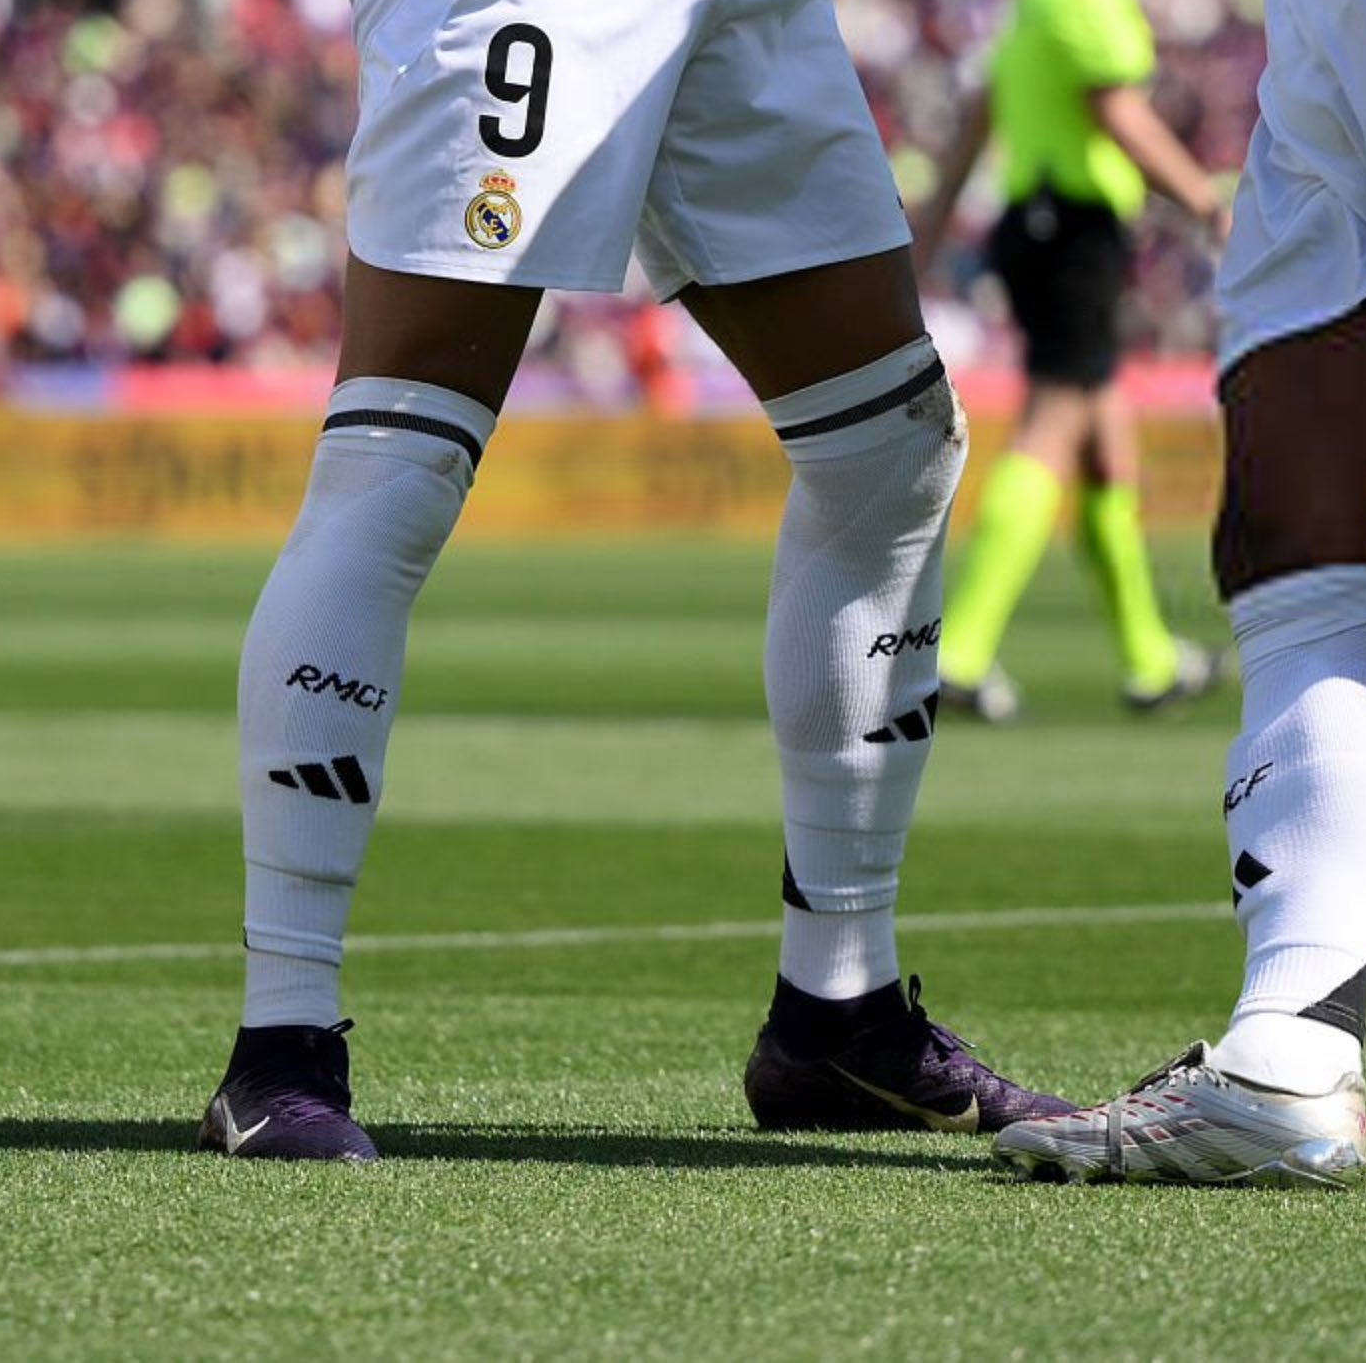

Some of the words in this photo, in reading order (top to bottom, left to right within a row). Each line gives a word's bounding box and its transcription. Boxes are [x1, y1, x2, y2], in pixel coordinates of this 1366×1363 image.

[478, 22, 554, 158] 9
[866, 616, 942, 659] RMC
[1224, 761, 1275, 822] CF
